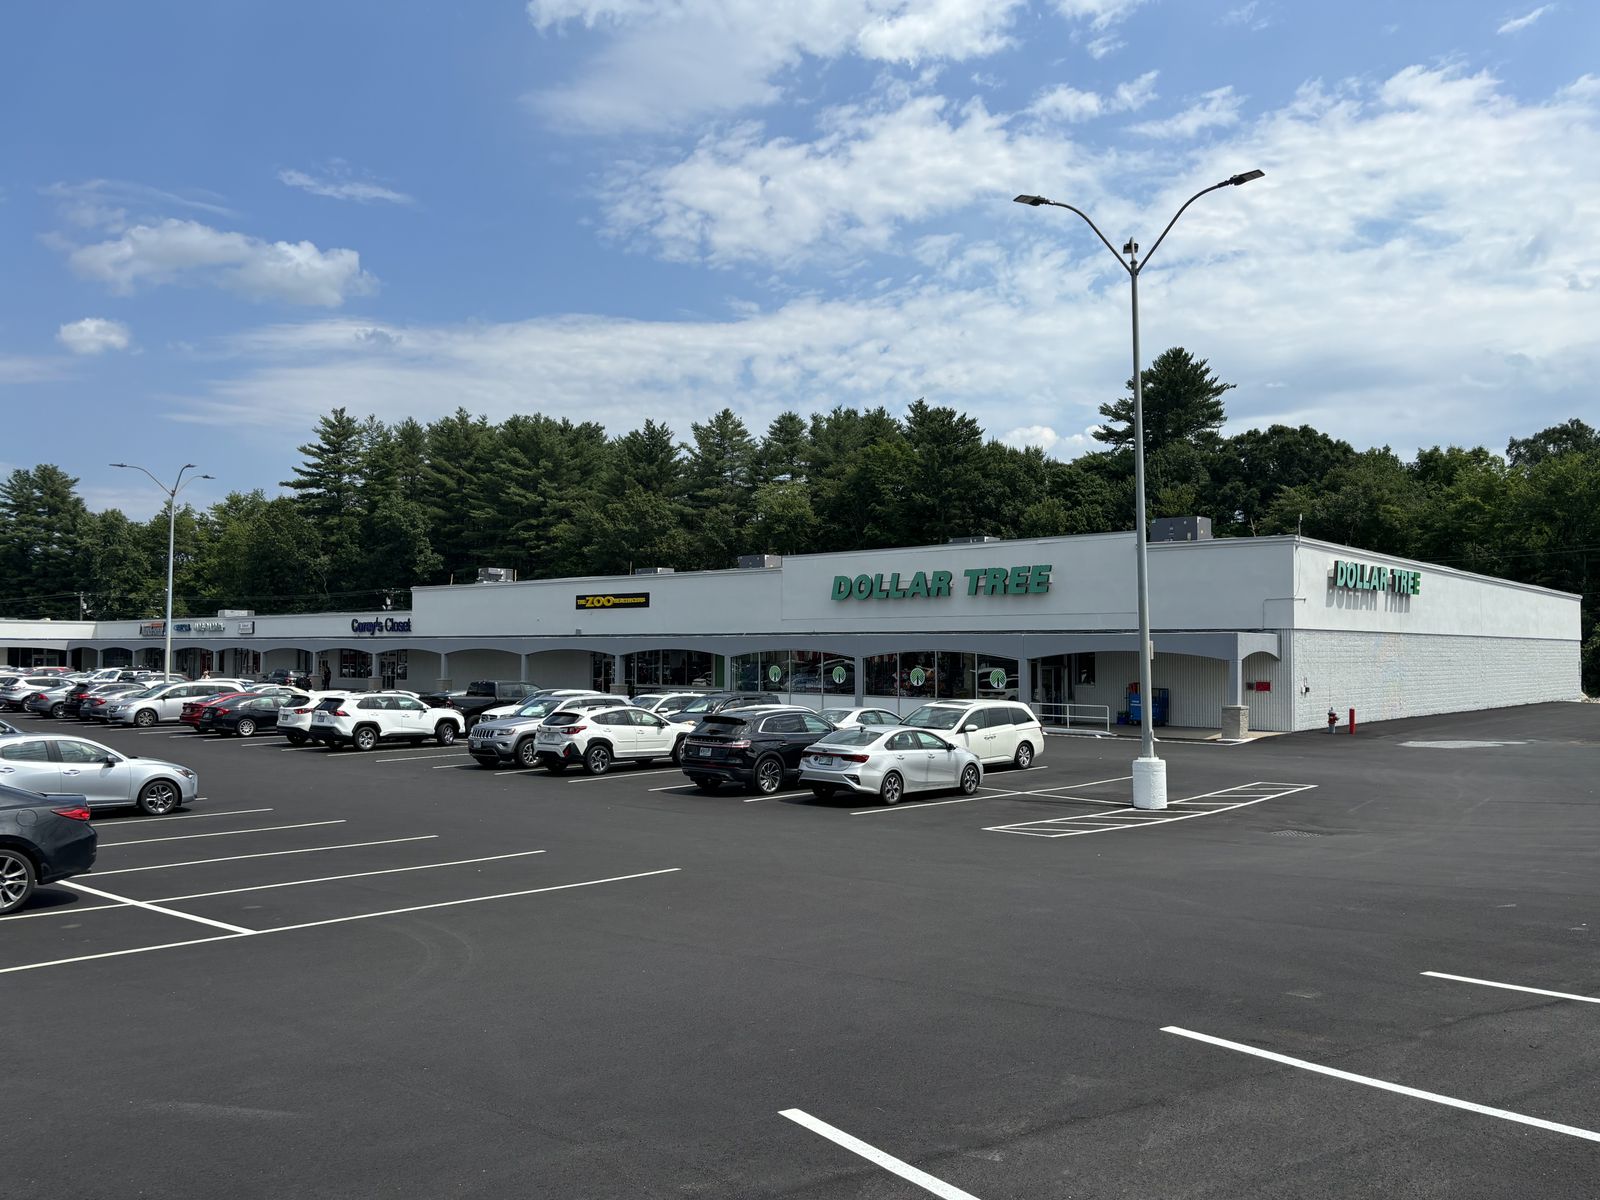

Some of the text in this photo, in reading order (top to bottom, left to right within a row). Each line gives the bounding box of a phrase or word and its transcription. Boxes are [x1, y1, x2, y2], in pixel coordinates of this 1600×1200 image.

[831, 565, 1052, 600] DOLLAR TREE
[1334, 560, 1421, 595] DOLLAR TREE
[586, 596, 614, 607] ZOO
[385, 617, 411, 632] Closet
